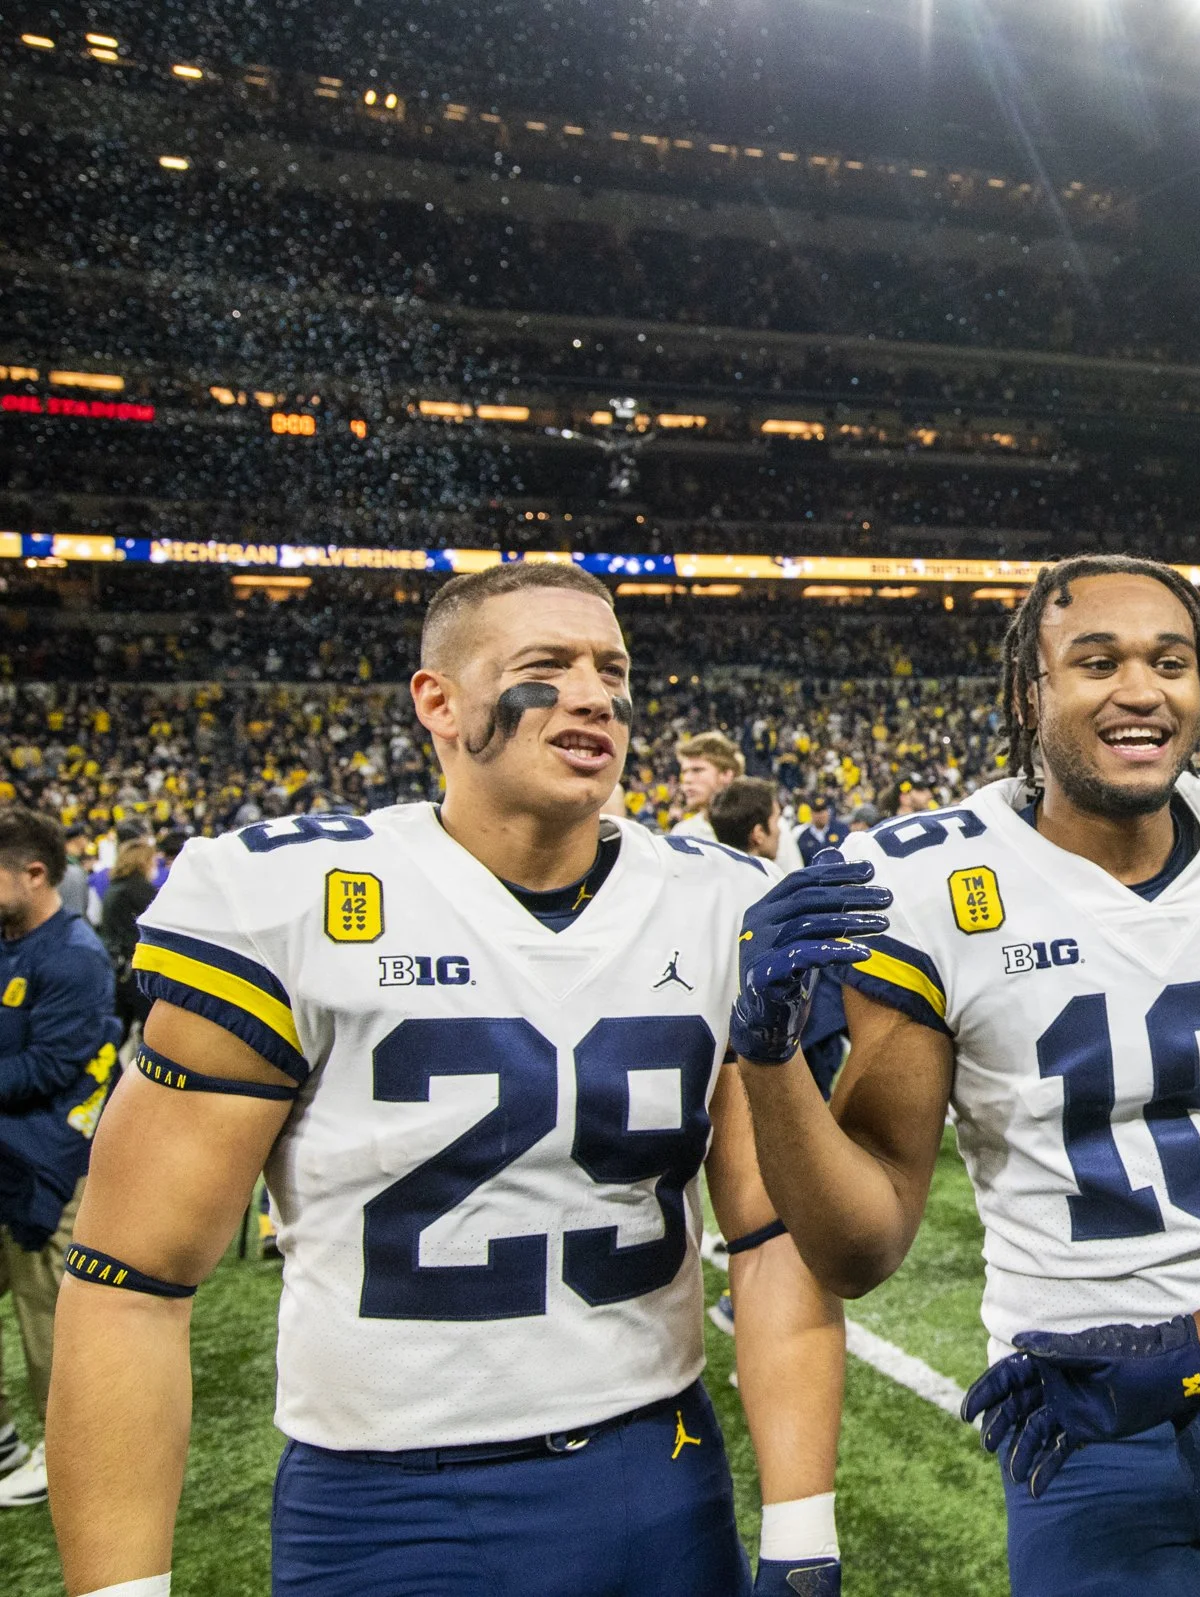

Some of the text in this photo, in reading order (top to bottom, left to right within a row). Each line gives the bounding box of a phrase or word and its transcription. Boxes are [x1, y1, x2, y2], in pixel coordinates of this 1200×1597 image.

[341, 880, 367, 896] TM
[962, 875, 985, 892] TM
[341, 897, 367, 914] 42
[966, 891, 988, 907] 42
[138, 1051, 187, 1089] ORDAN
[359, 1014, 717, 1321] 29
[66, 1248, 129, 1285] ORDAN
